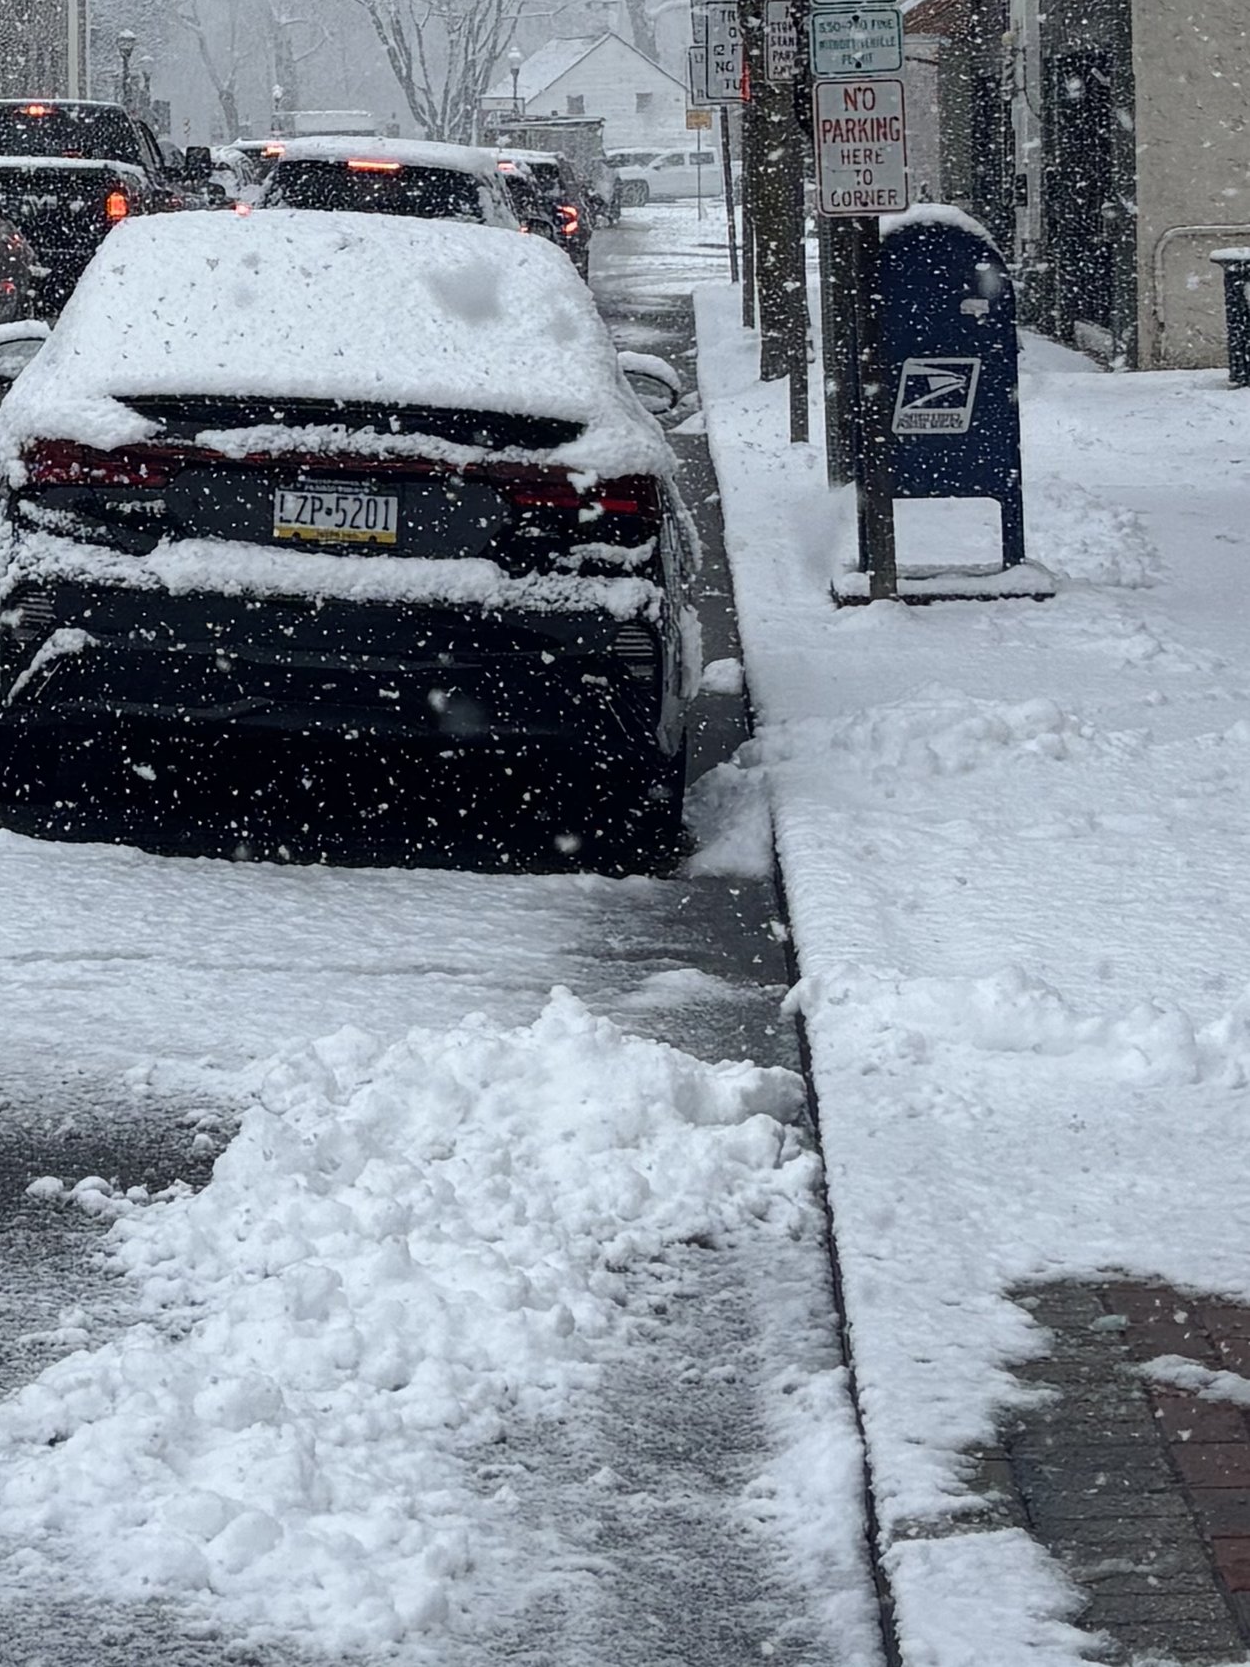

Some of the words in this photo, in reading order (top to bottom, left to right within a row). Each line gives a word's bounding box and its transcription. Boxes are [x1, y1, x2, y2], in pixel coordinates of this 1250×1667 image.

[844, 87, 875, 111] NO
[822, 116, 900, 143] PARKING
[841, 148, 885, 165] HERE
[854, 169, 873, 186] TO
[831, 189, 897, 207] CORNER
